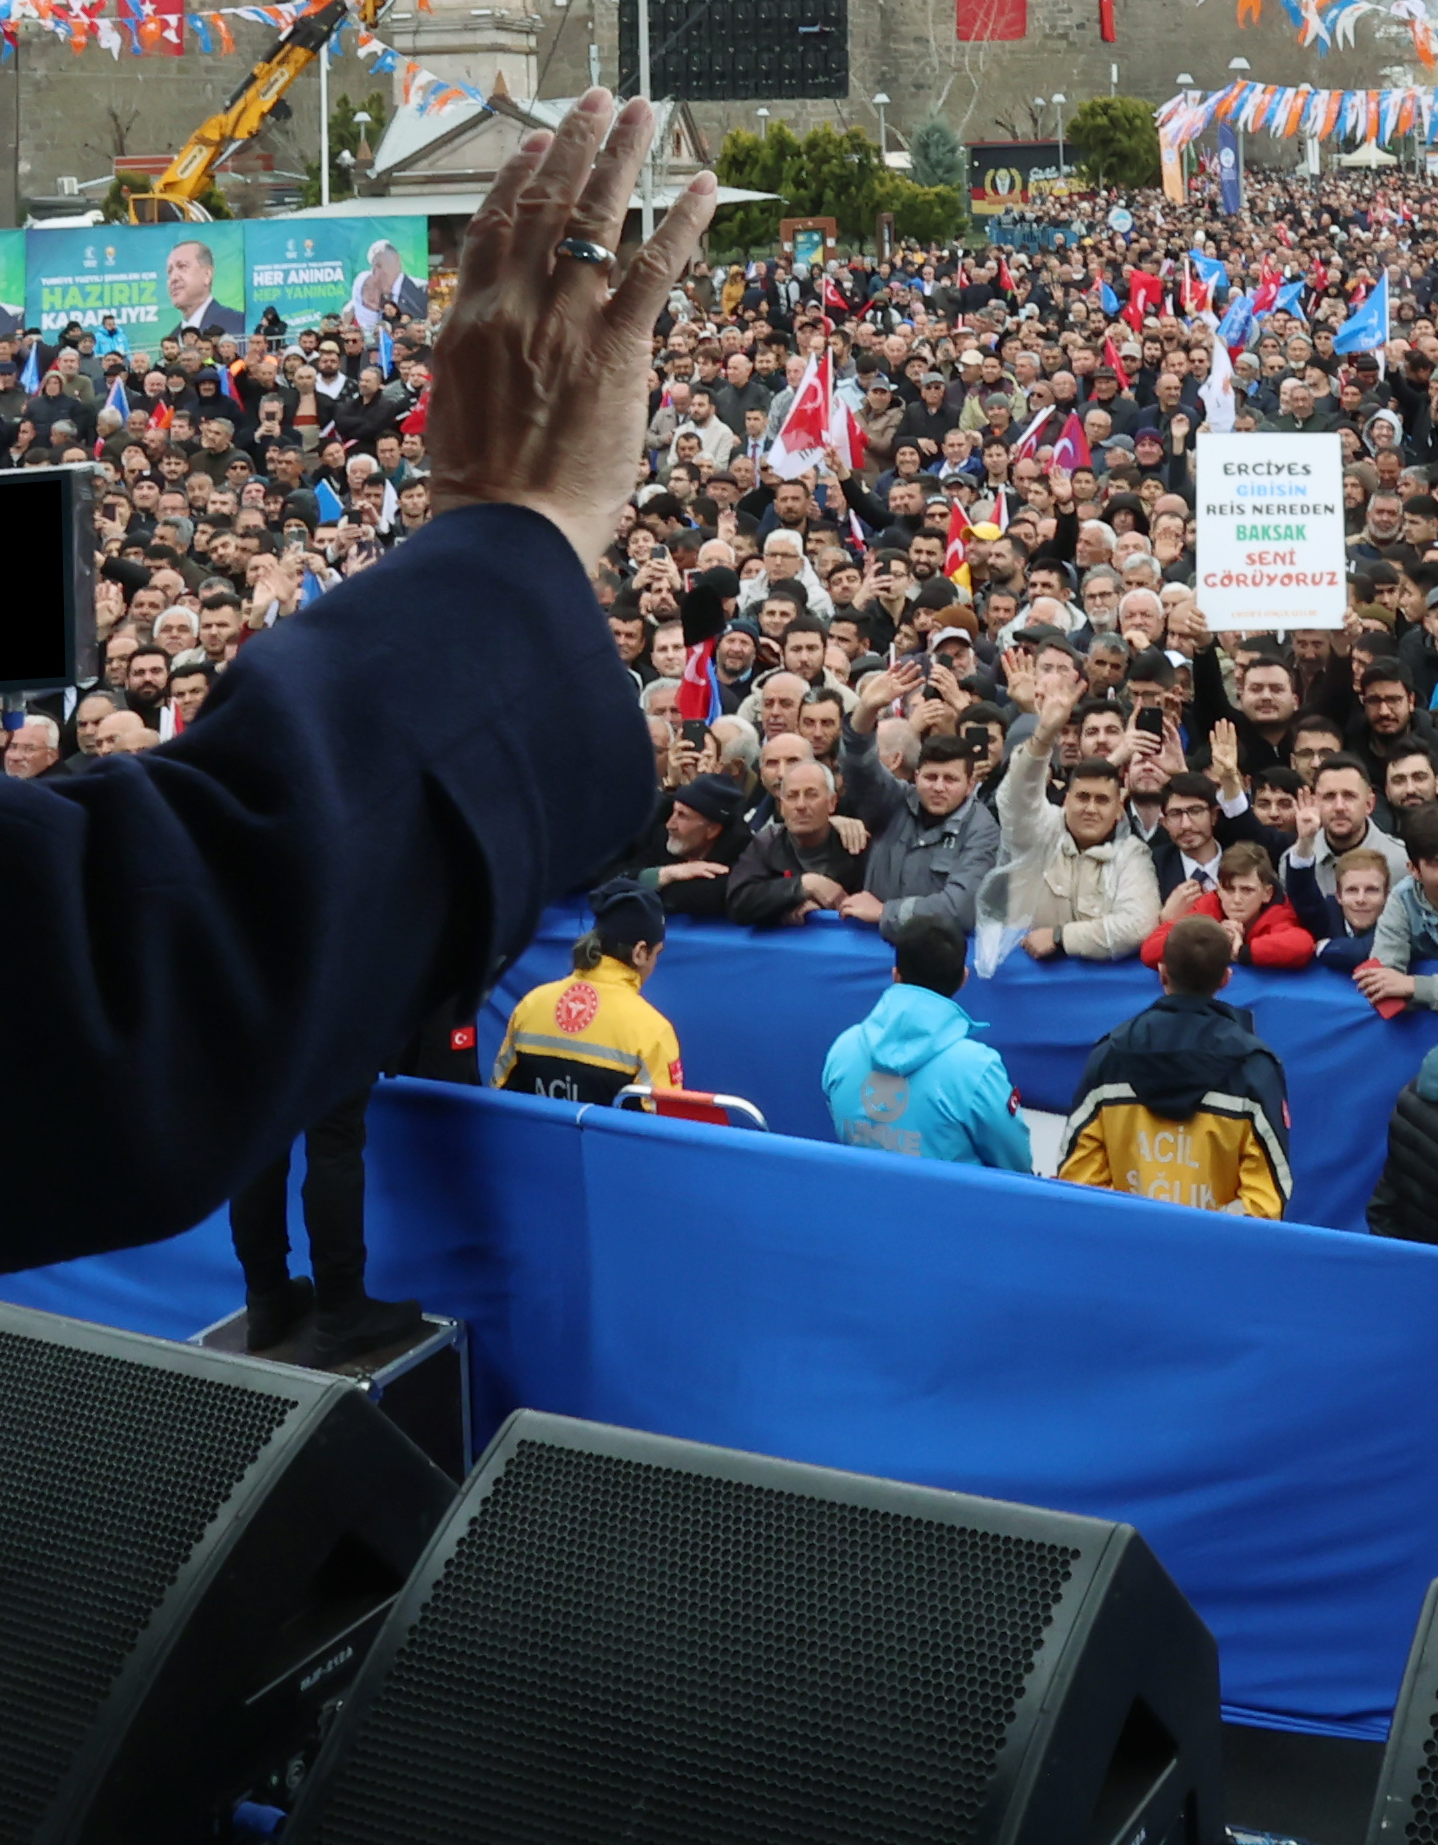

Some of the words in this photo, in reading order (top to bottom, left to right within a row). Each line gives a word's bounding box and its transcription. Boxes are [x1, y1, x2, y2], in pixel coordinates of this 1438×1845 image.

[253, 271, 284, 287] HER
[288, 267, 345, 284] ANINDA
[42, 281, 157, 310] HAZIRIZ
[1223, 460, 1312, 476] ERCİYES
[1206, 500, 1246, 515] REİS
[1252, 503, 1335, 515] NEREDEN
[1236, 524, 1307, 542] BAKSAK
[1245, 548, 1296, 566] SENİ
[1204, 570, 1339, 589] GÖRÜYORUZ
[1137, 1125, 1200, 1168] ACİL
